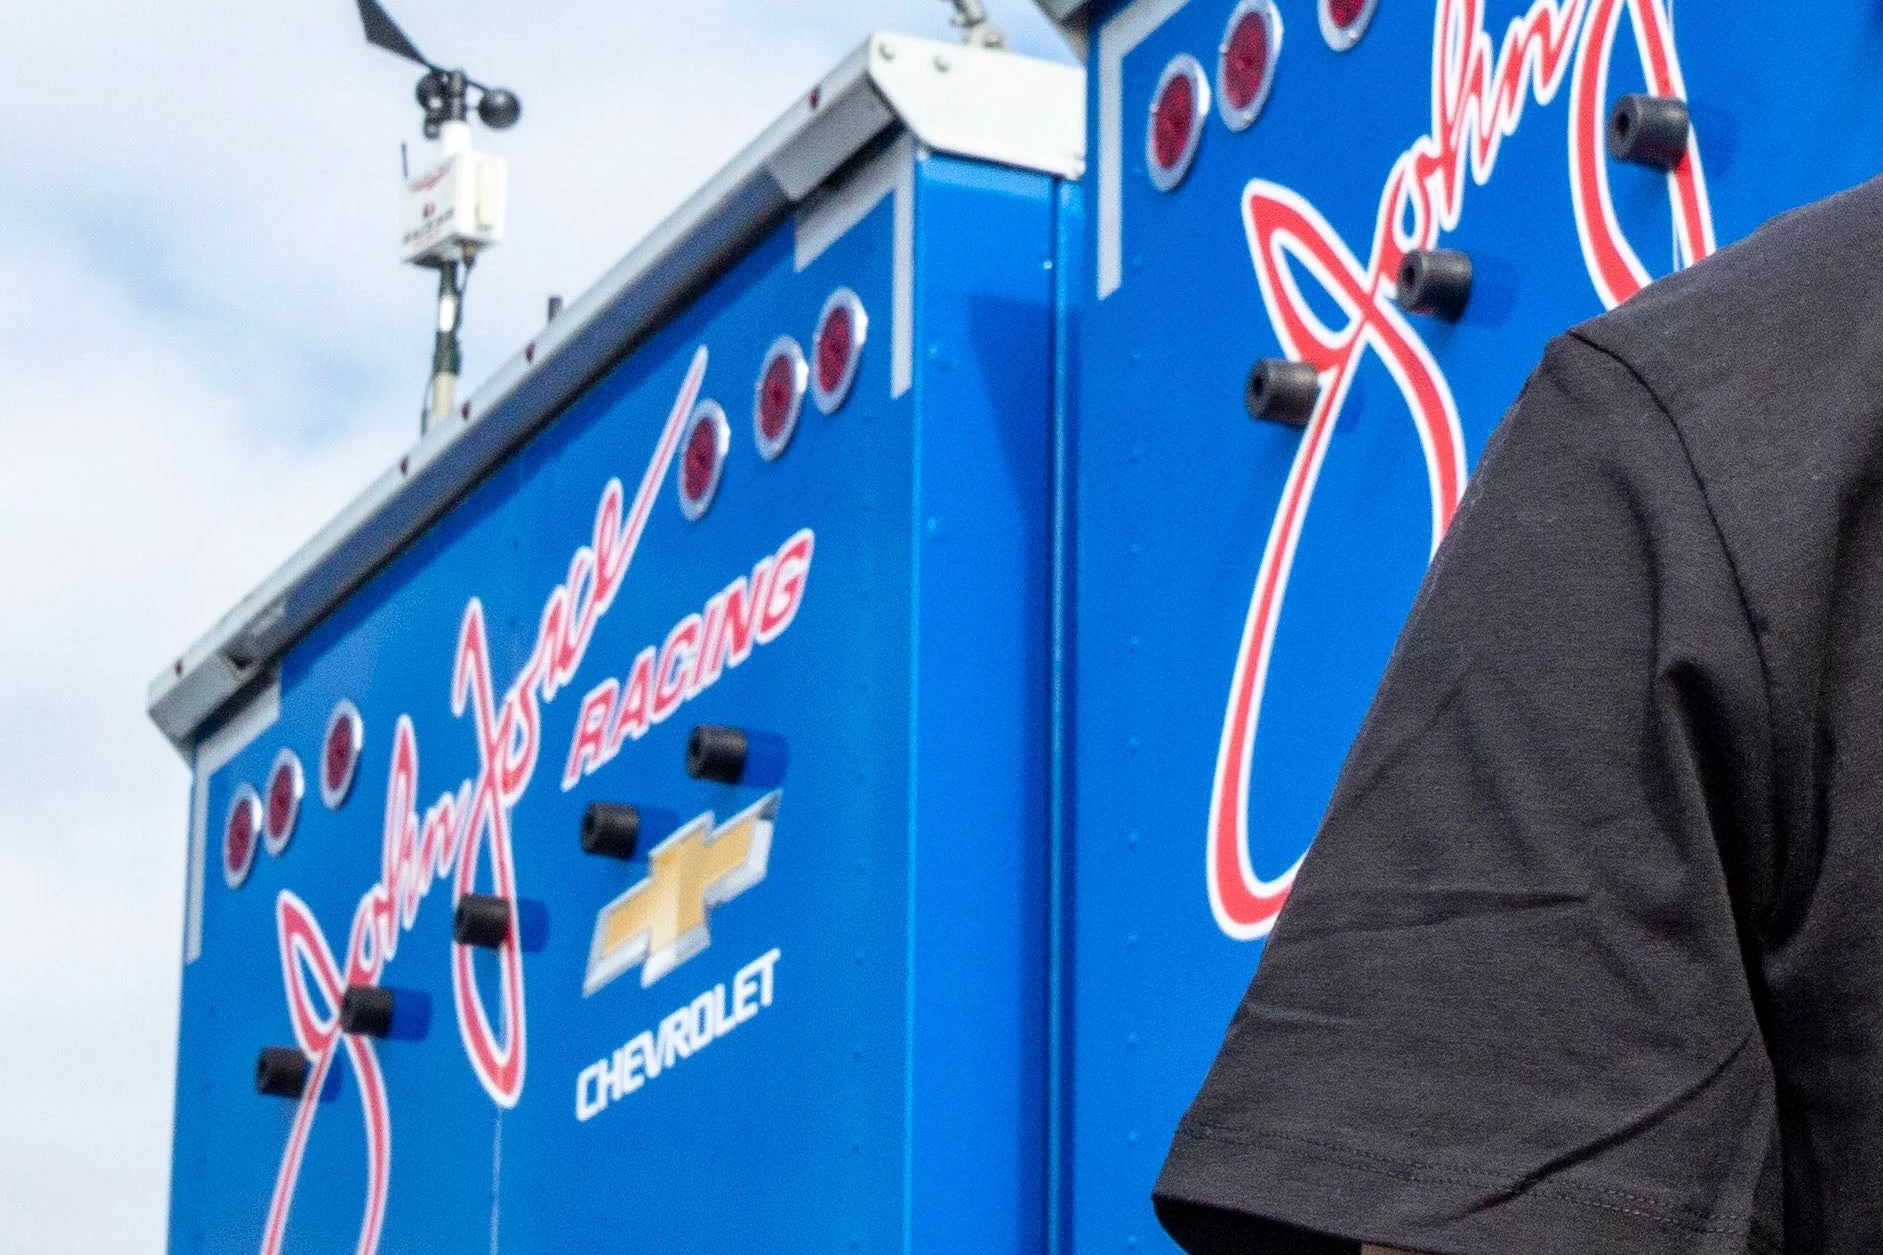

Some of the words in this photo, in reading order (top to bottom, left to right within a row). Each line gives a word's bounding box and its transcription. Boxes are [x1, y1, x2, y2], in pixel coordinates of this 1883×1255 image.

[561, 530, 815, 790] RACING
[259, 715, 472, 1255] John
[452, 345, 708, 1108] Force
[576, 948, 781, 1122] CHEVROLET
